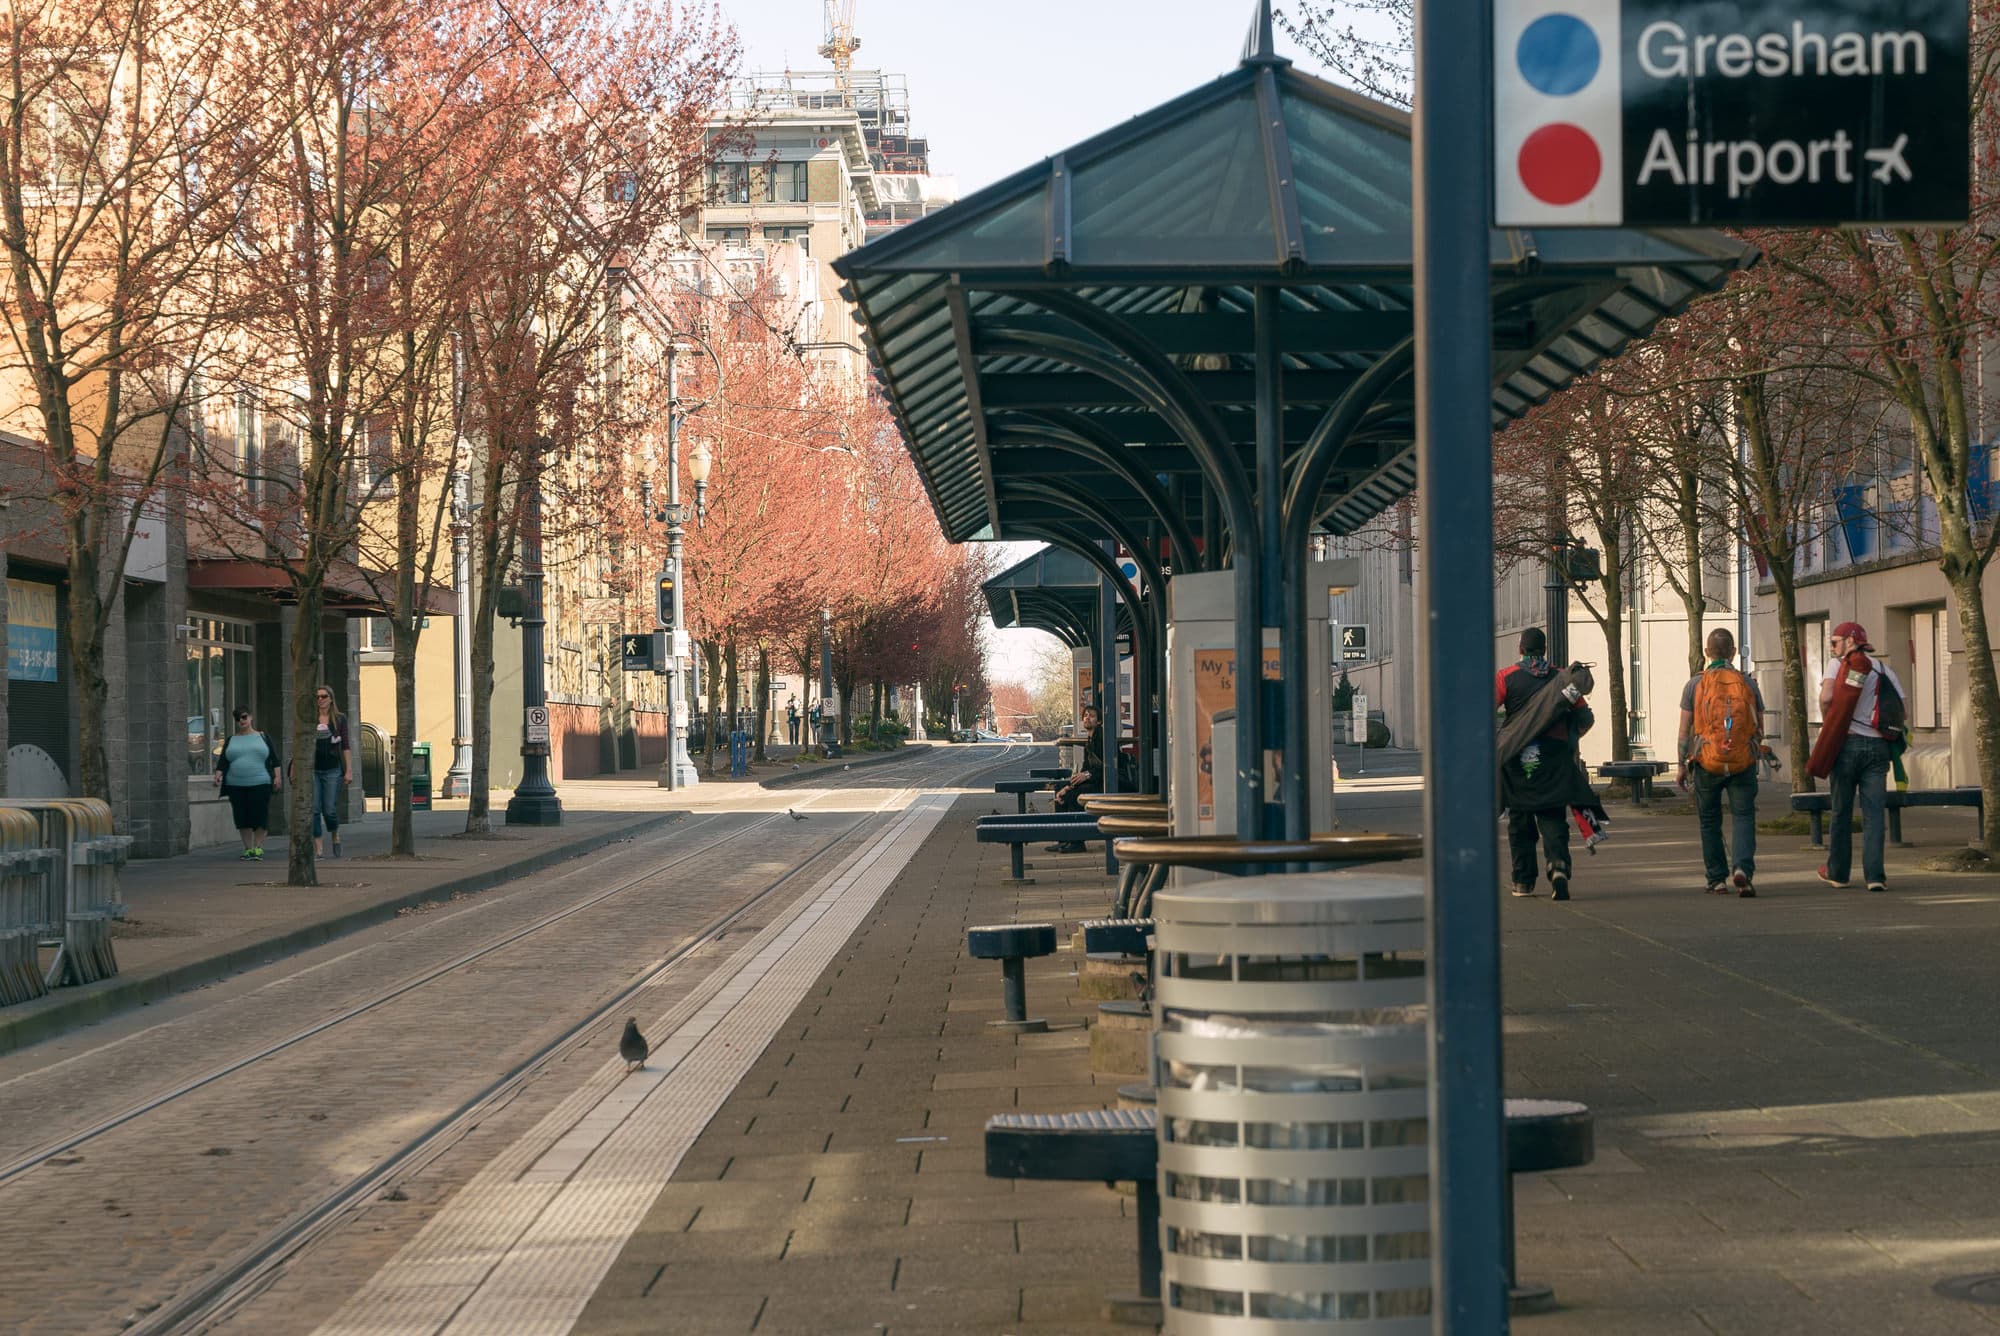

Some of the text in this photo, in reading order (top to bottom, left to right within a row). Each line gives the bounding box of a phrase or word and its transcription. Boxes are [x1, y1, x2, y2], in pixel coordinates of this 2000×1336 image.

[1637, 20, 1927, 78] Gresham
[1637, 128, 1853, 199] Airport
[1200, 660, 1222, 675] My
[1221, 676, 1231, 690] is
